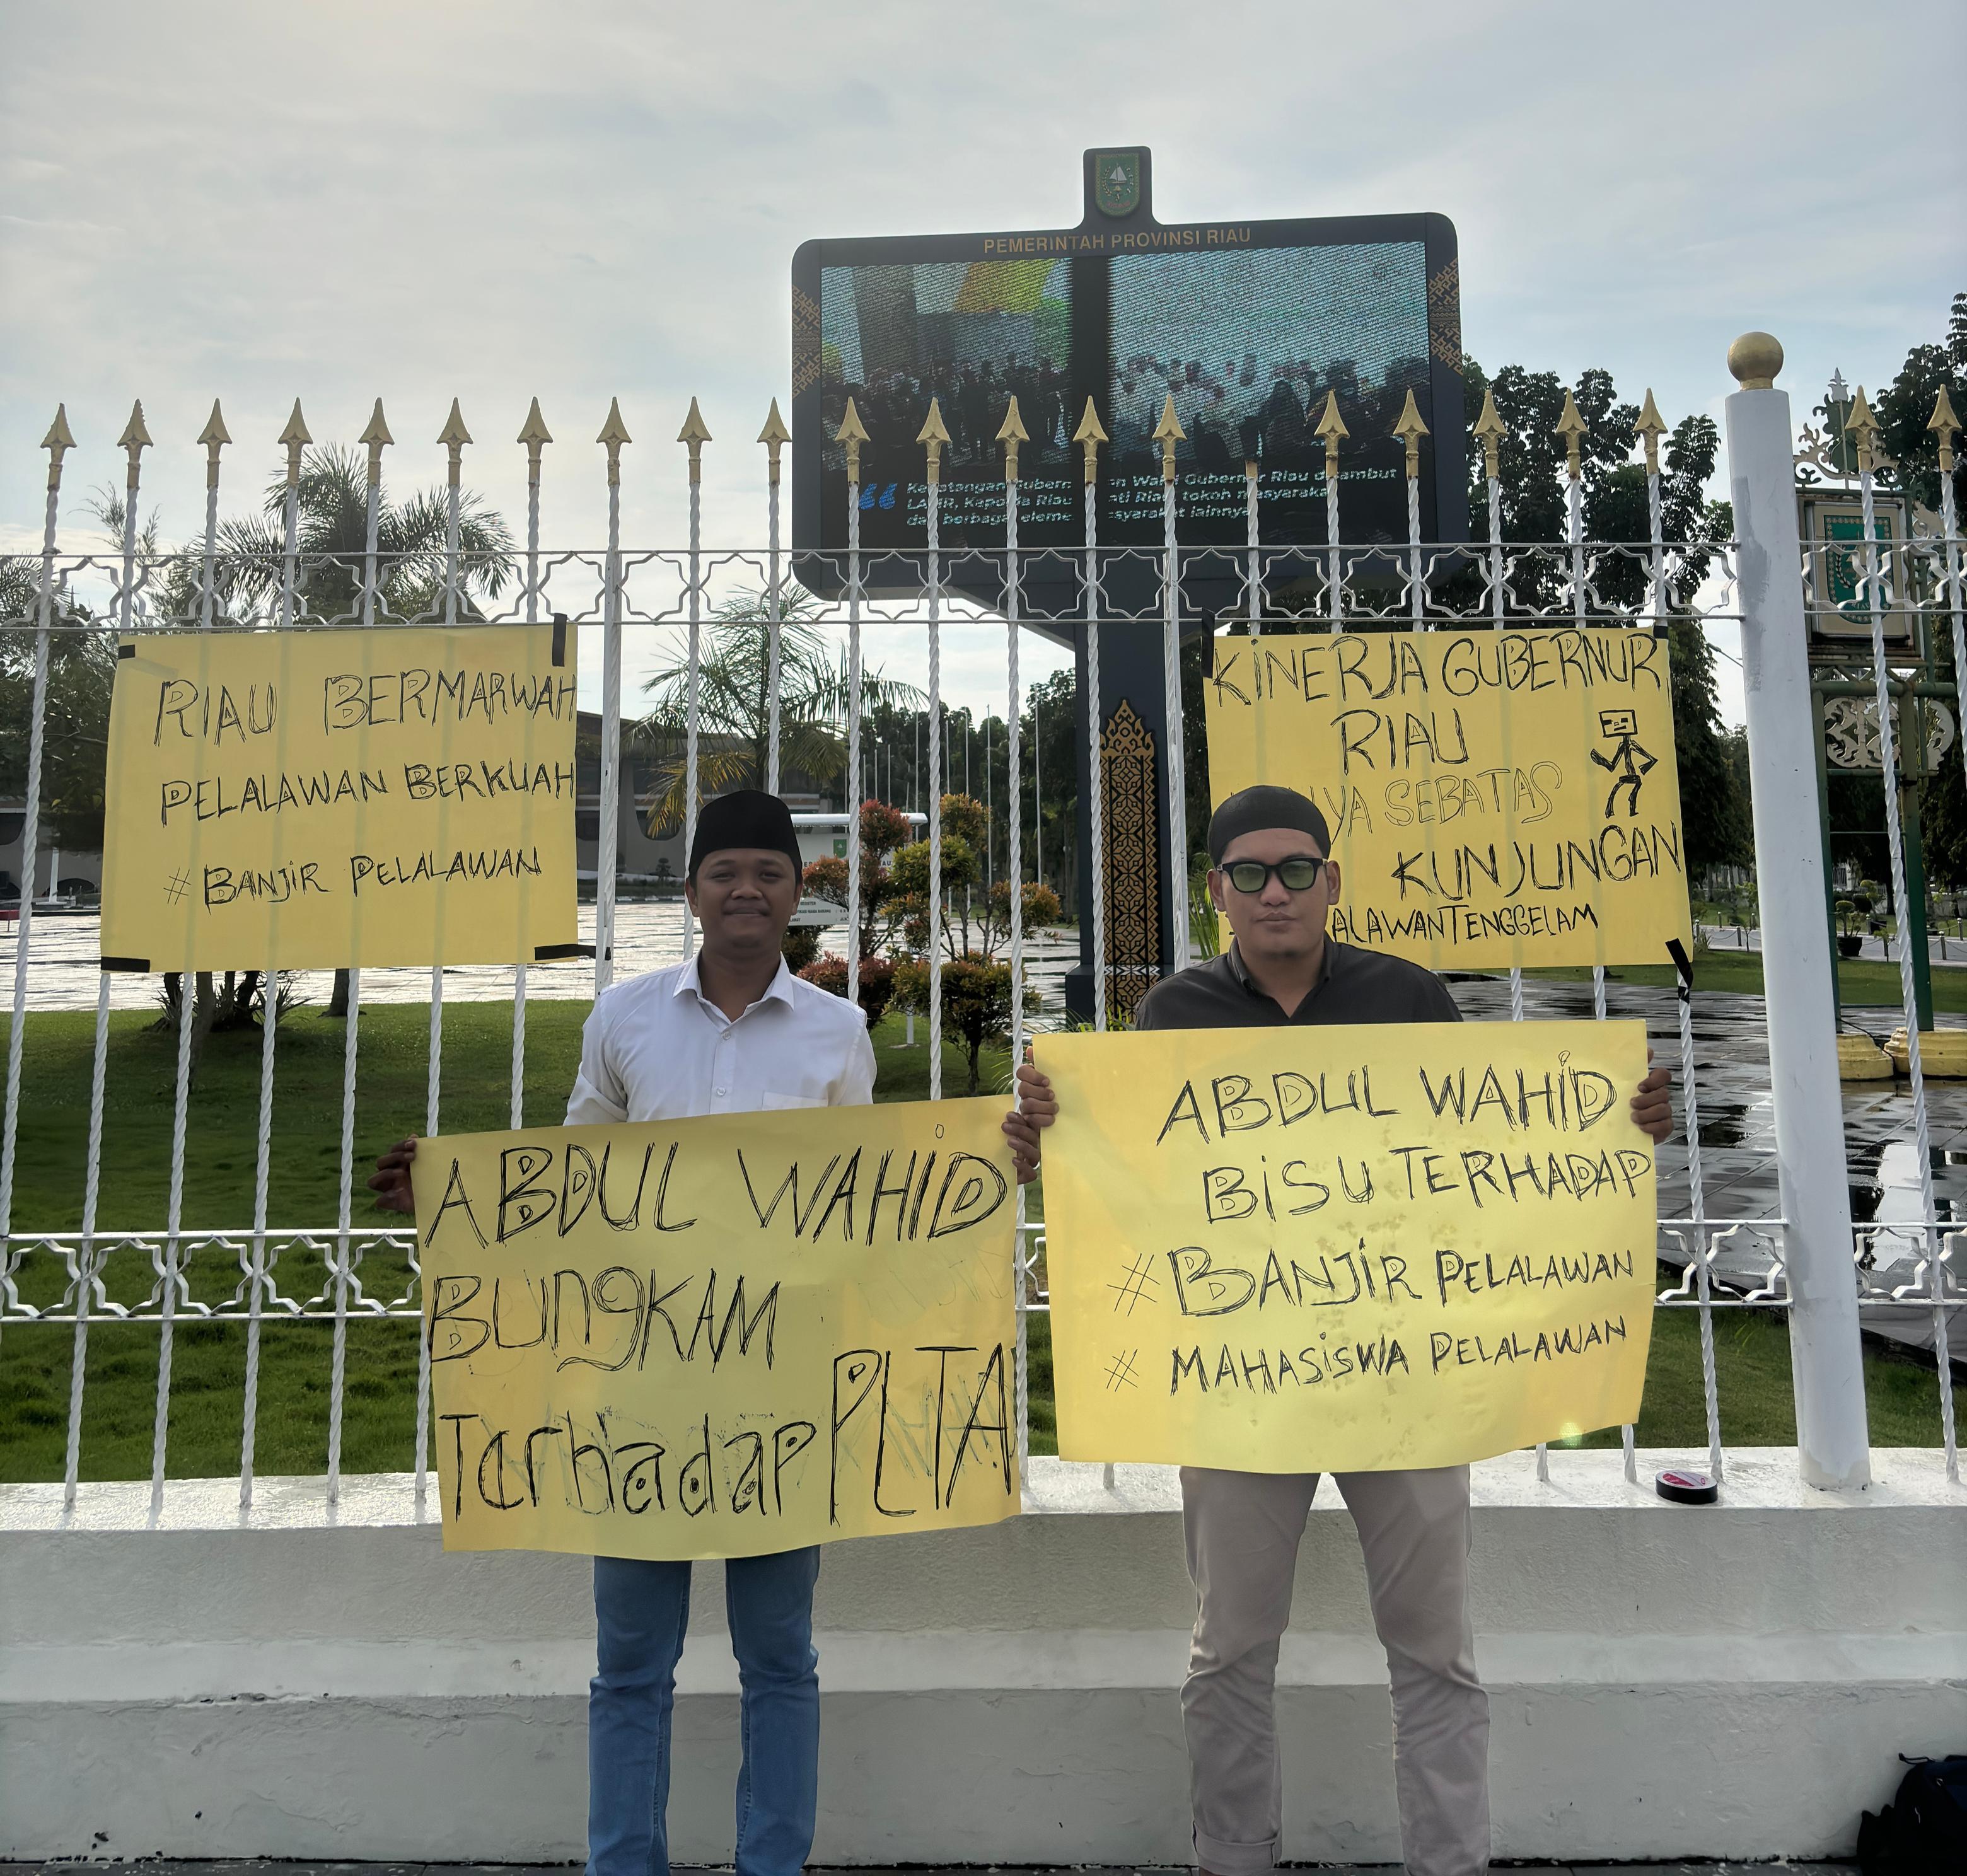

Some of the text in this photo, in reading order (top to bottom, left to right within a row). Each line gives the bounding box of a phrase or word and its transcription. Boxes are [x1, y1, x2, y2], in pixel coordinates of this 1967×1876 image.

[984, 228, 1251, 253] PEMERINTAH PROVINSI RIAU
[907, 482, 1006, 494] Keatangan
[1133, 474, 1180, 487] Wakl
[1185, 472, 1266, 485] Gubernr
[1271, 470, 1309, 482] Riau
[1314, 468, 1397, 481] dambut
[907, 497, 958, 510] LAR,
[1182, 489, 1231, 502] tokoh
[1237, 486, 1327, 501] masyaraka
[943, 512, 1008, 526] berbaga
[1442, 629, 1662, 697] GUBERNUR
[154, 668, 576, 746] RIAU BERMARWAH
[1330, 708, 1469, 776] RIAU
[161, 758, 575, 828] PELALAWAN BERKUAH
[1384, 761, 1562, 826] SEBATAS
[350, 845, 542, 898] PELALAWAN
[1391, 820, 1681, 901] KUNJUNGAN
[1157, 1065, 1398, 1145] ABDUL
[425, 1125, 1008, 1248] ABDUL WAHID
[1390, 1145, 1652, 1208] TERHADAP
[1436, 1249, 1633, 1307] PELALAWAN
[1430, 1316, 1625, 1375] PELALAWAN
[830, 1343, 1013, 1526] PLTA
